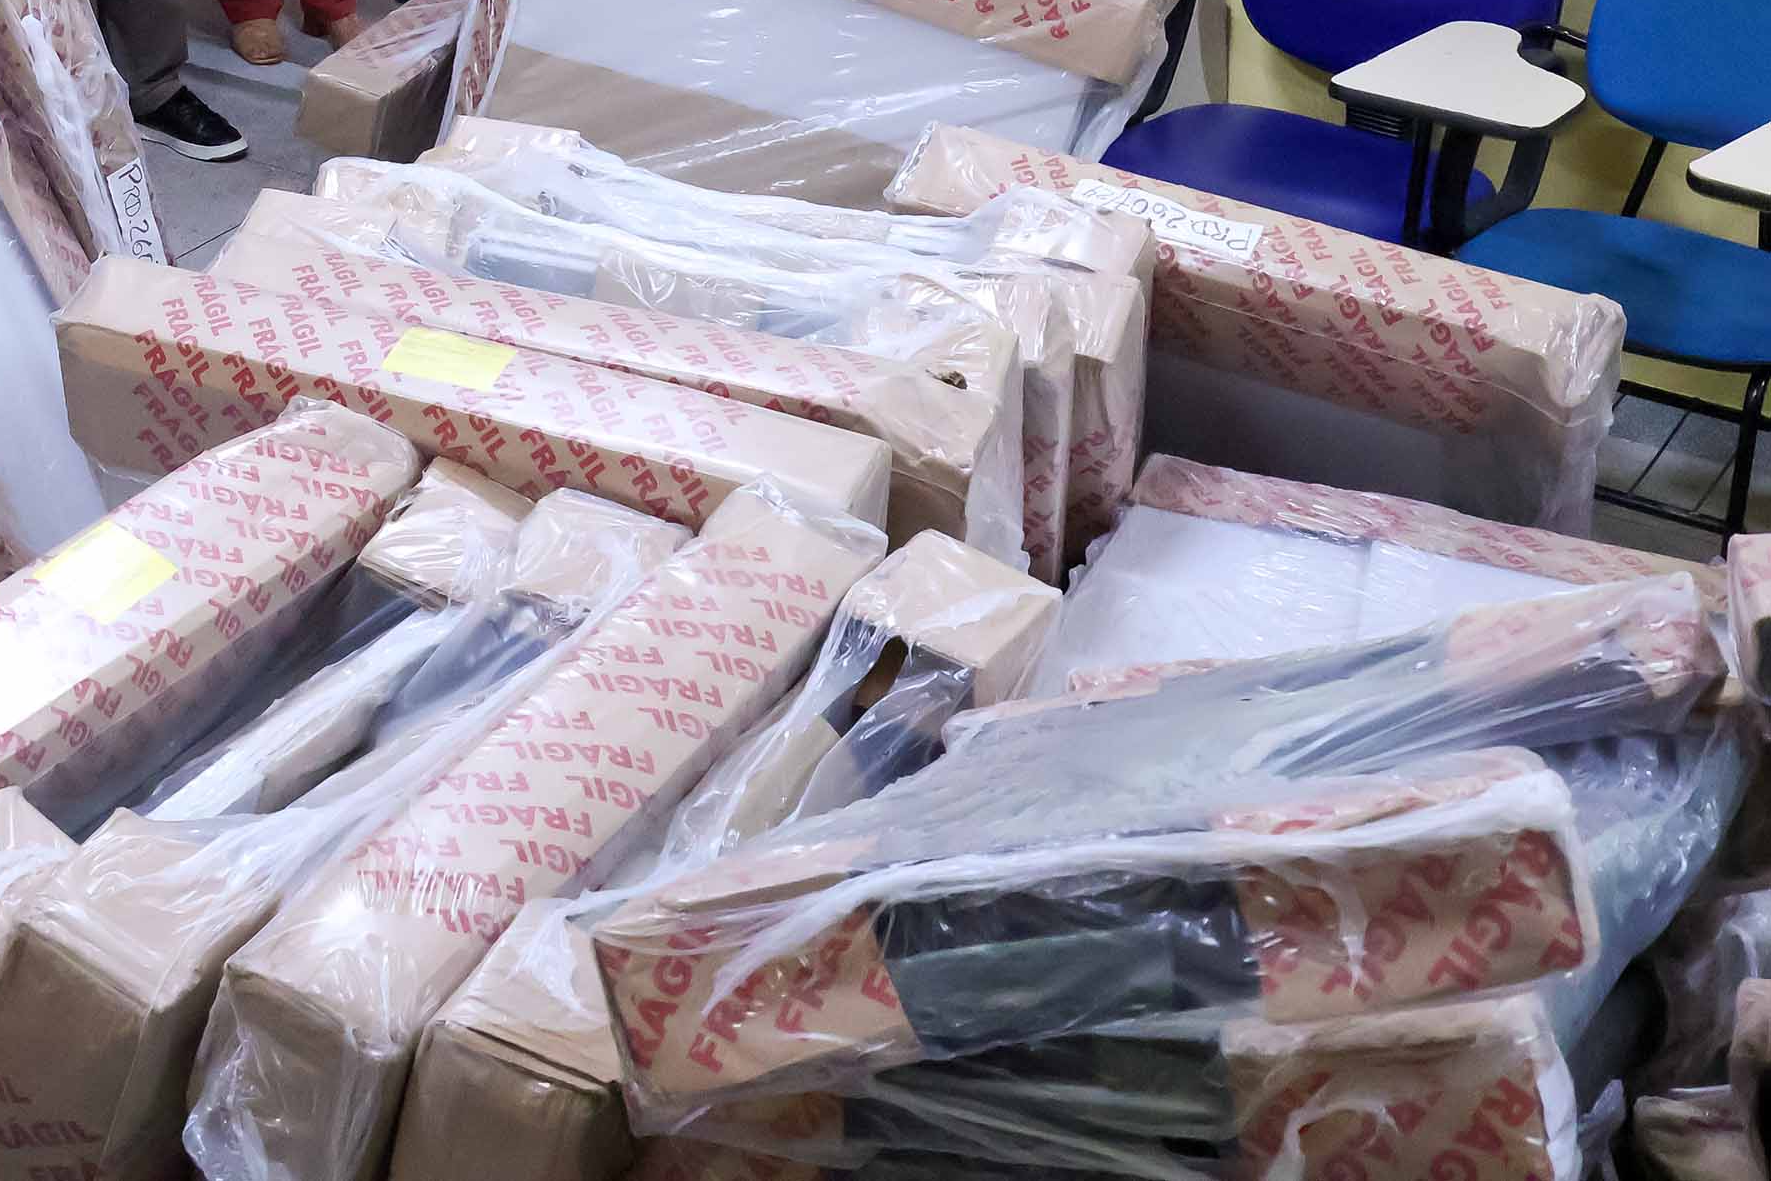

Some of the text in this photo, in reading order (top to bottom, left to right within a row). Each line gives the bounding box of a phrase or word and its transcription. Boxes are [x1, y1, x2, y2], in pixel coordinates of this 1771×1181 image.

[291, 475, 386, 520] RÁGIL
[138, 530, 244, 564] FRÁG
[1428, 827, 1568, 991] RÁGIL
